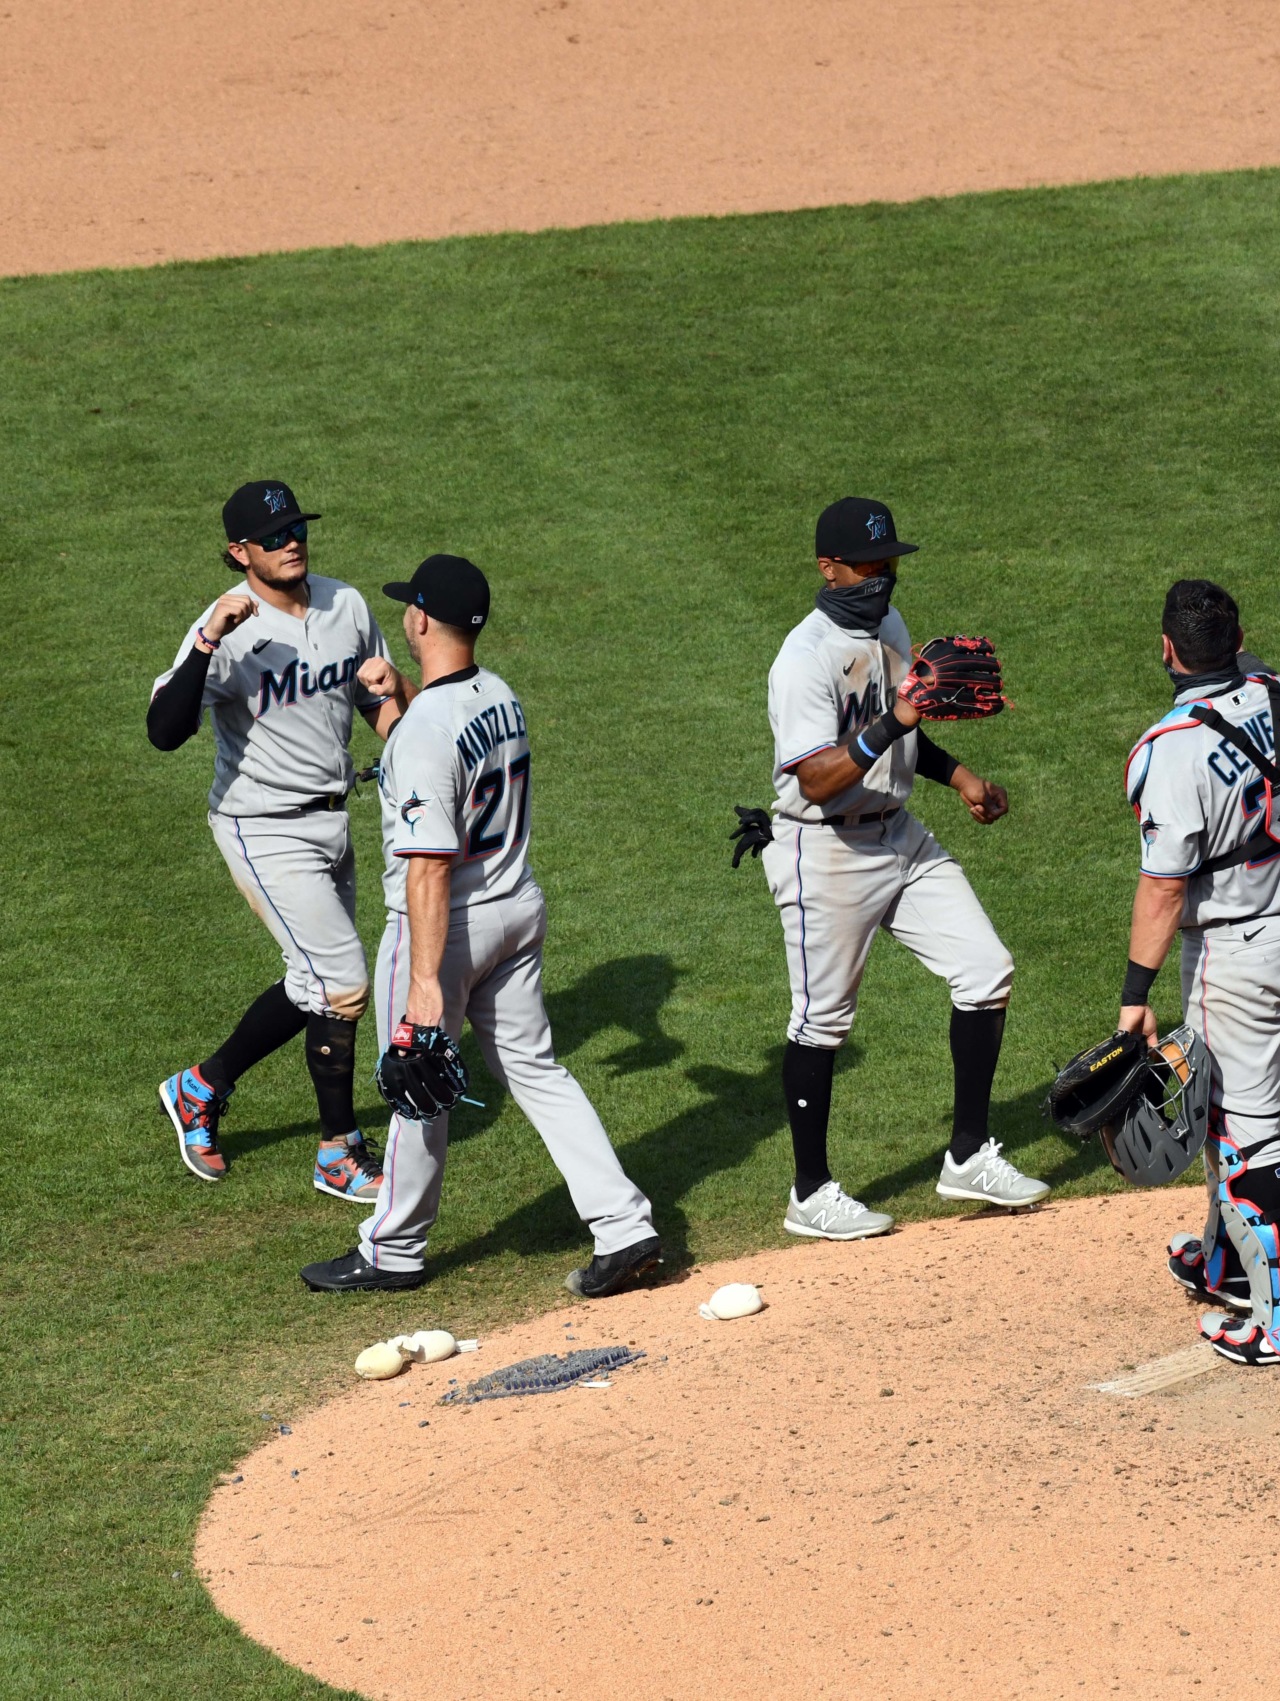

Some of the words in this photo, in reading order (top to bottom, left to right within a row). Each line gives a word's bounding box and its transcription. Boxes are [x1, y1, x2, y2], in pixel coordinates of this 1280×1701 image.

[254, 655, 359, 720] Miam
[838, 679, 897, 736] Mia
[456, 700, 528, 772] KINTZLE
[464, 752, 531, 861] 27
[1090, 1046, 1123, 1072] EASTON
